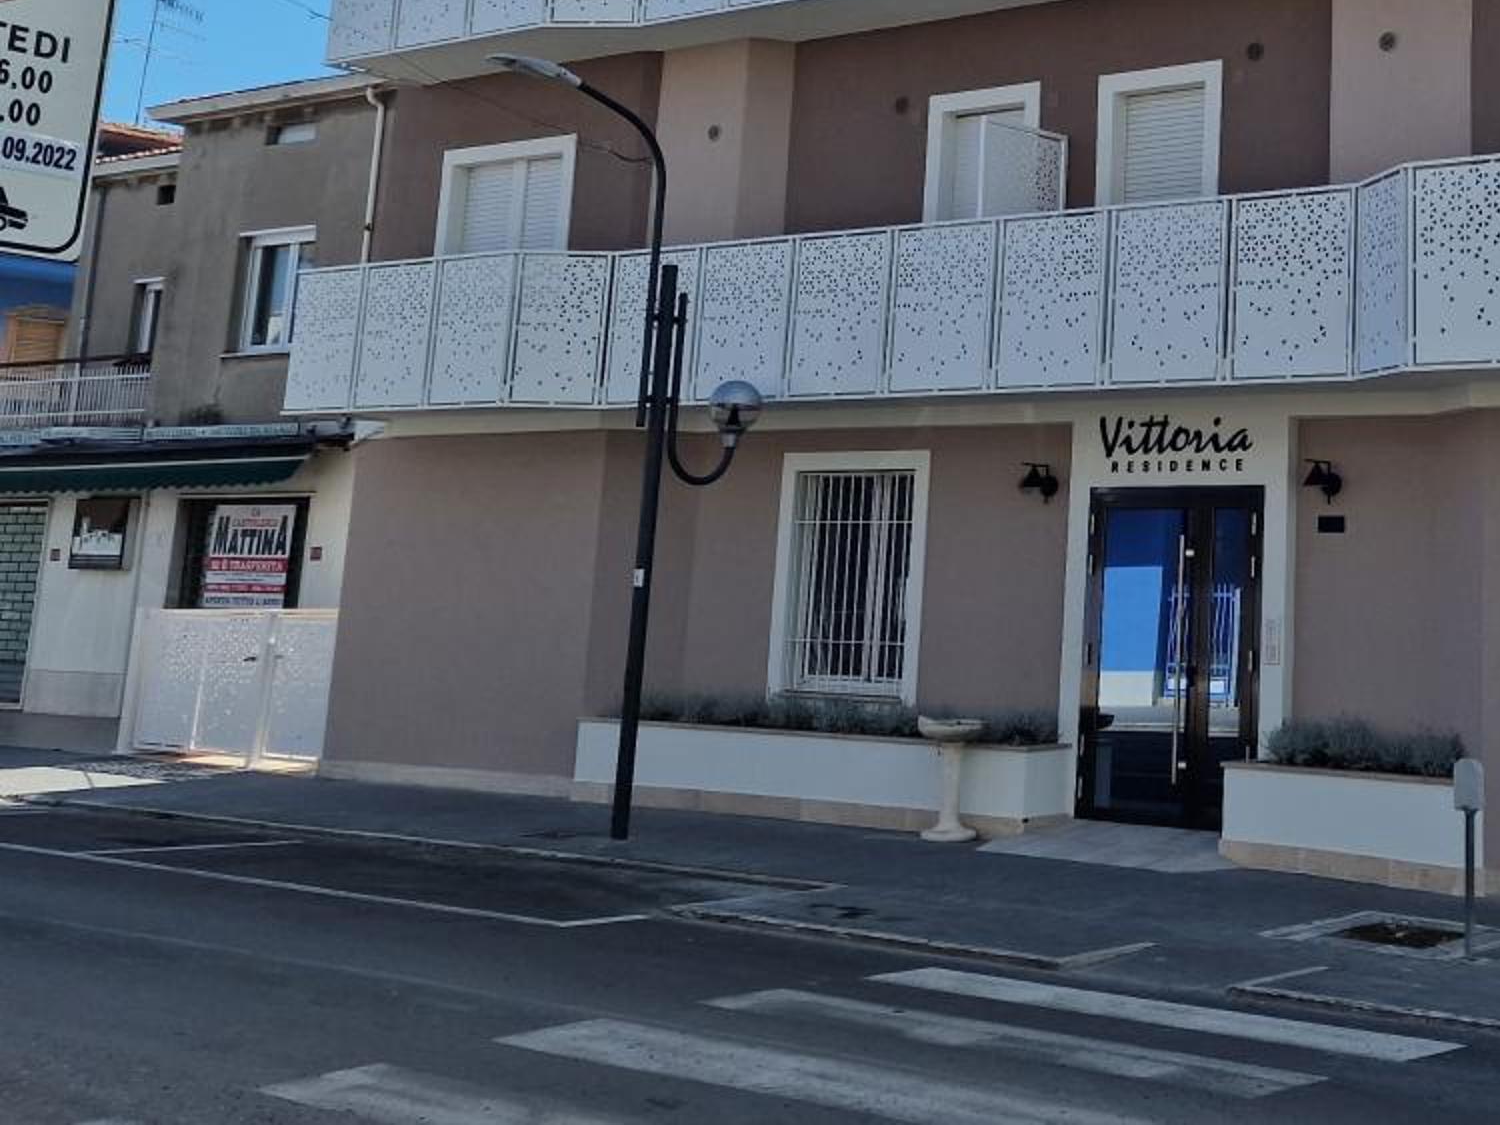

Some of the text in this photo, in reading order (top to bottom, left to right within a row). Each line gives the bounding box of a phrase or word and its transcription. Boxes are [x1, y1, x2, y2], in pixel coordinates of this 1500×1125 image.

[2, 136, 77, 172] 09.2022
[1100, 415, 1253, 458] Vittoria
[1111, 459, 1243, 473] RESIDENCE
